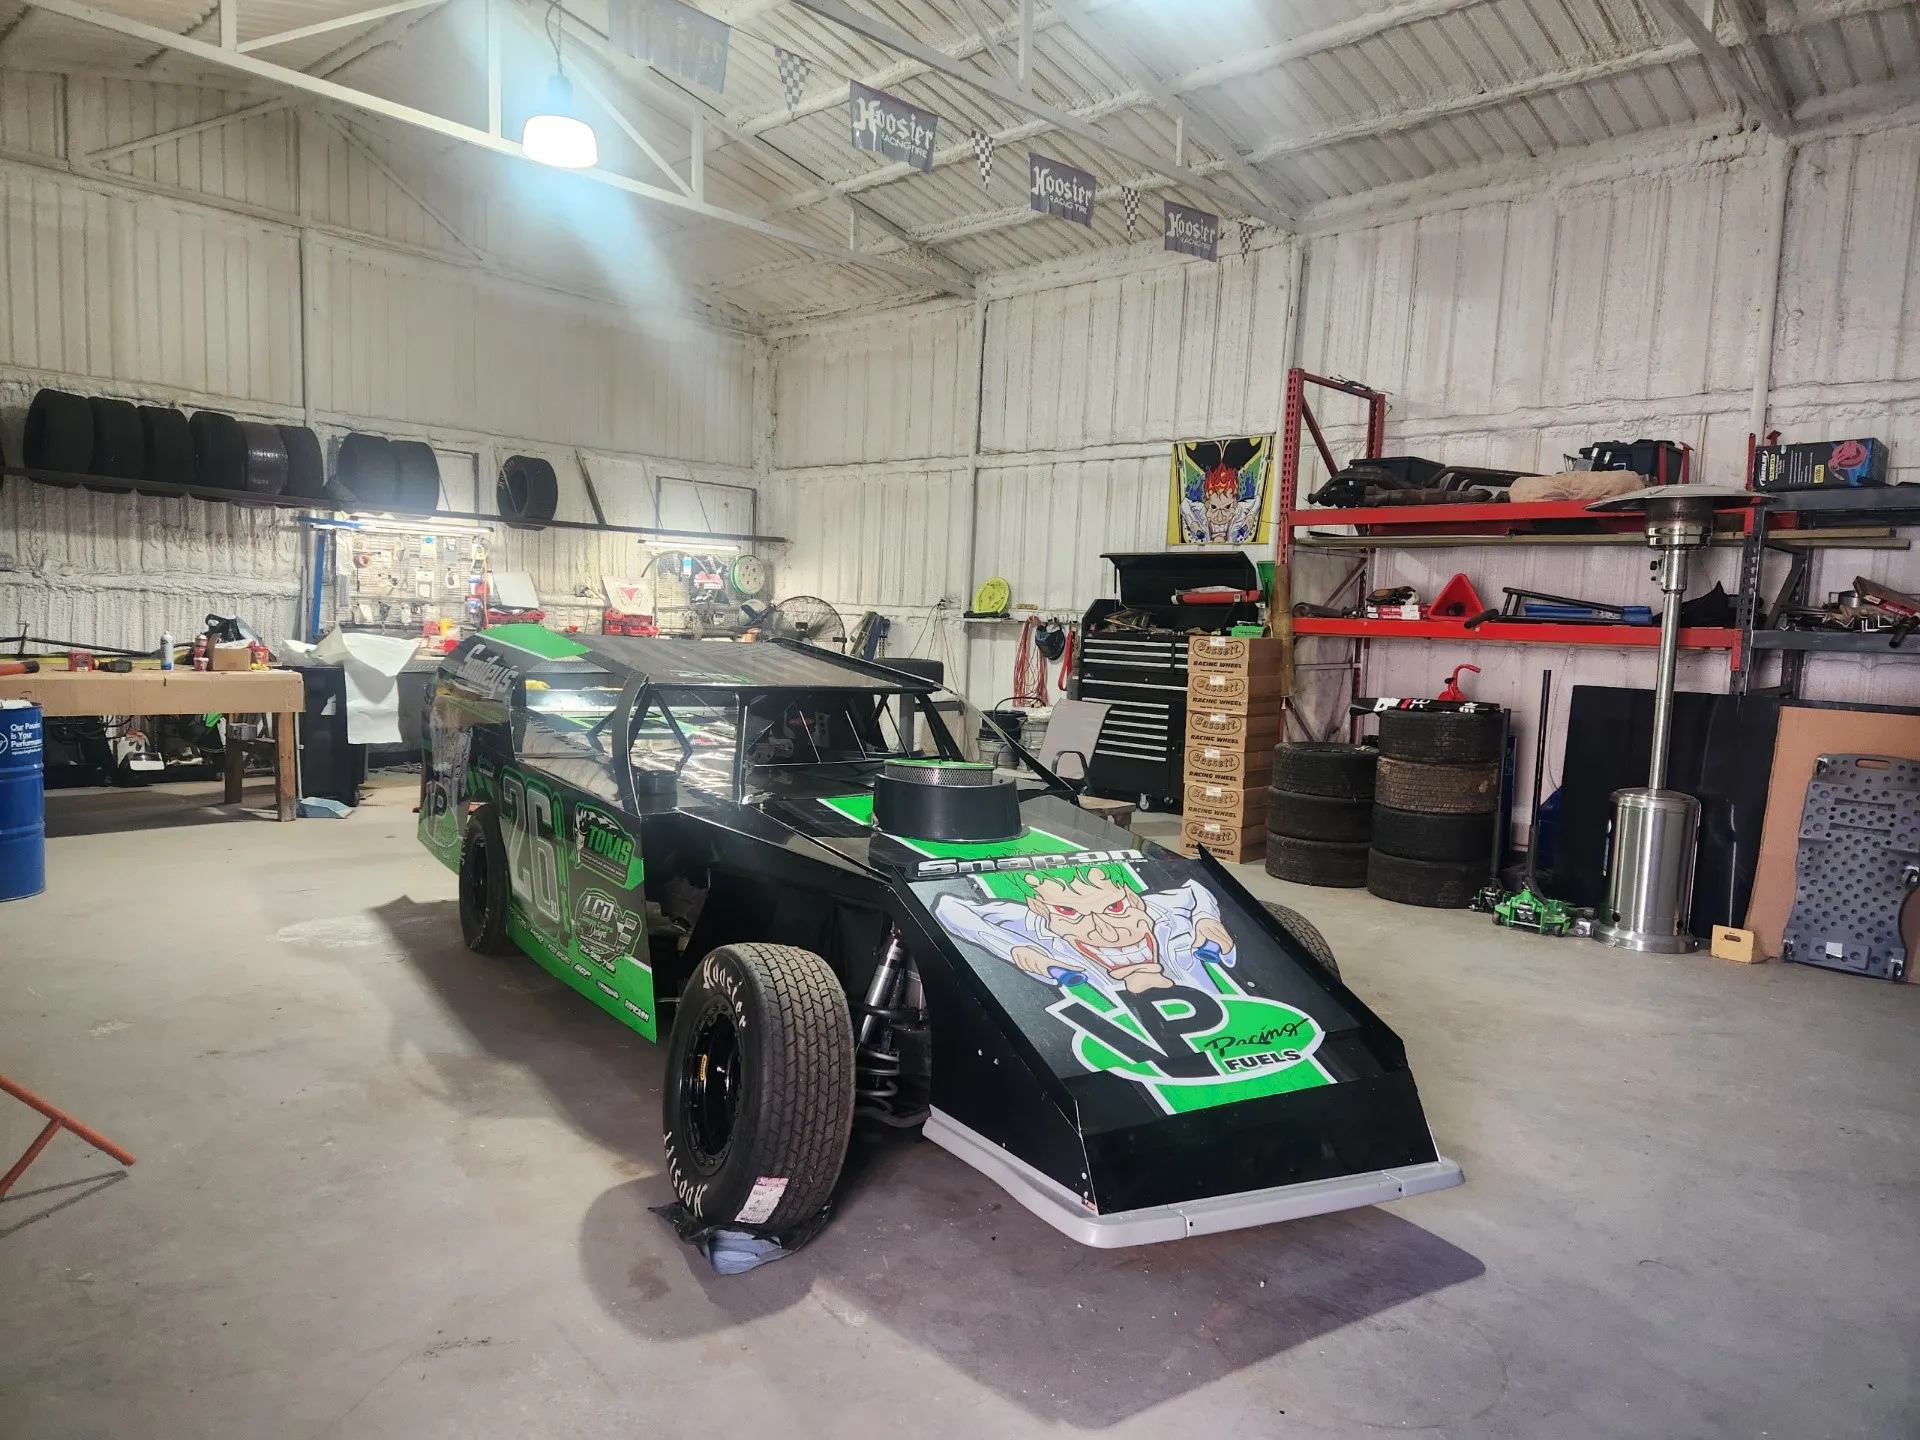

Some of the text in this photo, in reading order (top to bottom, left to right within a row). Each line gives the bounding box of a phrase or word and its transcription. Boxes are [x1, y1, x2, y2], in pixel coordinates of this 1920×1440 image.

[853, 97, 934, 150] Hoosier
[1031, 166, 1093, 206] Hoosier
[1166, 212, 1215, 243] Hoosier
[457, 643, 520, 697] Smiley's
[10, 723, 24, 731] Our
[503, 776, 559, 921] 26
[588, 825, 632, 867] TOMS
[918, 850, 1144, 877] Snap-on
[1212, 847, 1235, 855] WHEEL
[582, 895, 615, 923] LCD
[703, 956, 747, 1028] Hoosier
[1058, 985, 1224, 1079] VP
[1225, 1049, 1301, 1072] FUELS
